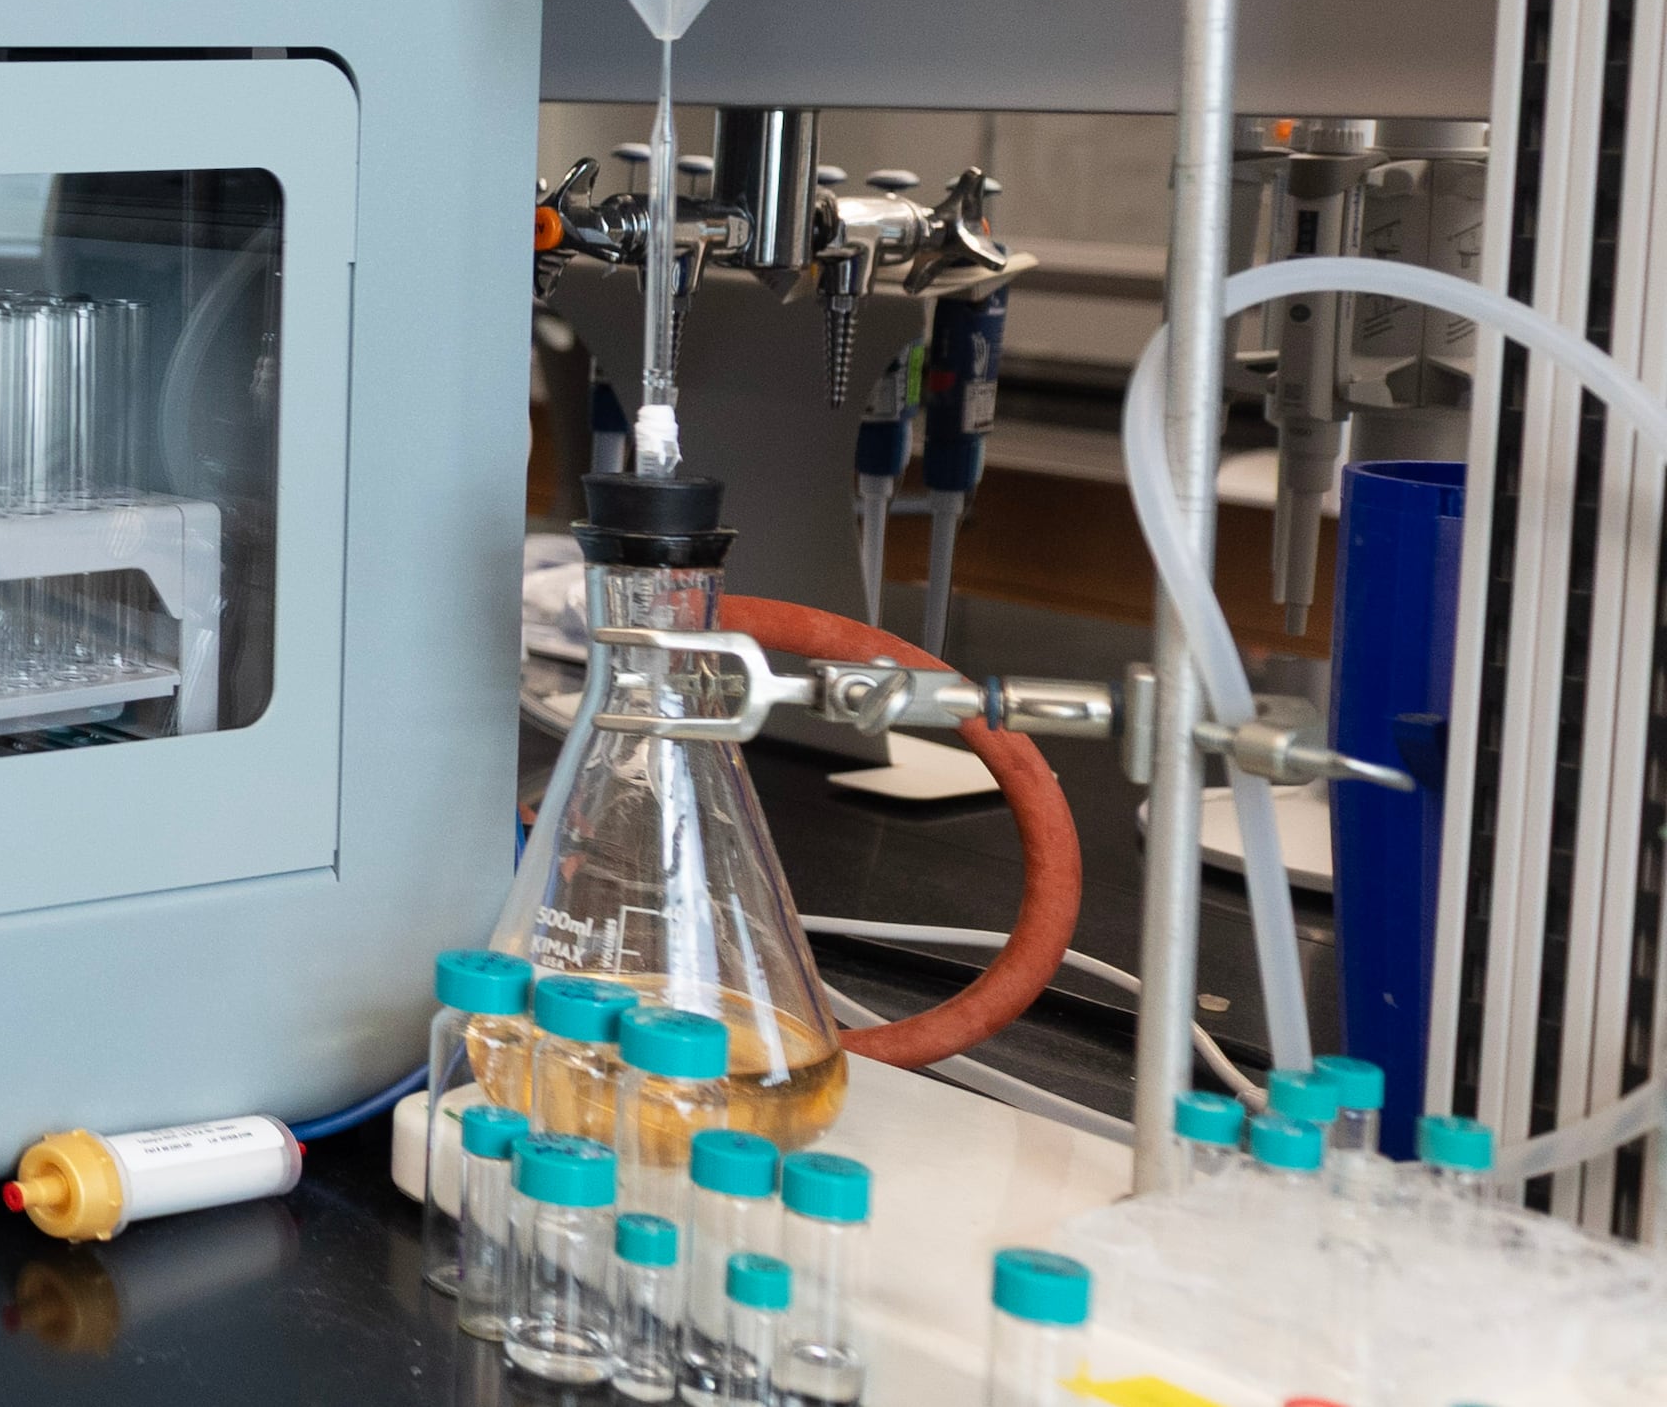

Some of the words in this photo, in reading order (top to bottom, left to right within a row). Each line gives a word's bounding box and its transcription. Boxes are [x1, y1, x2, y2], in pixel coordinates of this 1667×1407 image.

[535, 905, 594, 938] 500ml
[530, 933, 588, 969] KIMAX
[541, 956, 566, 971] USA
